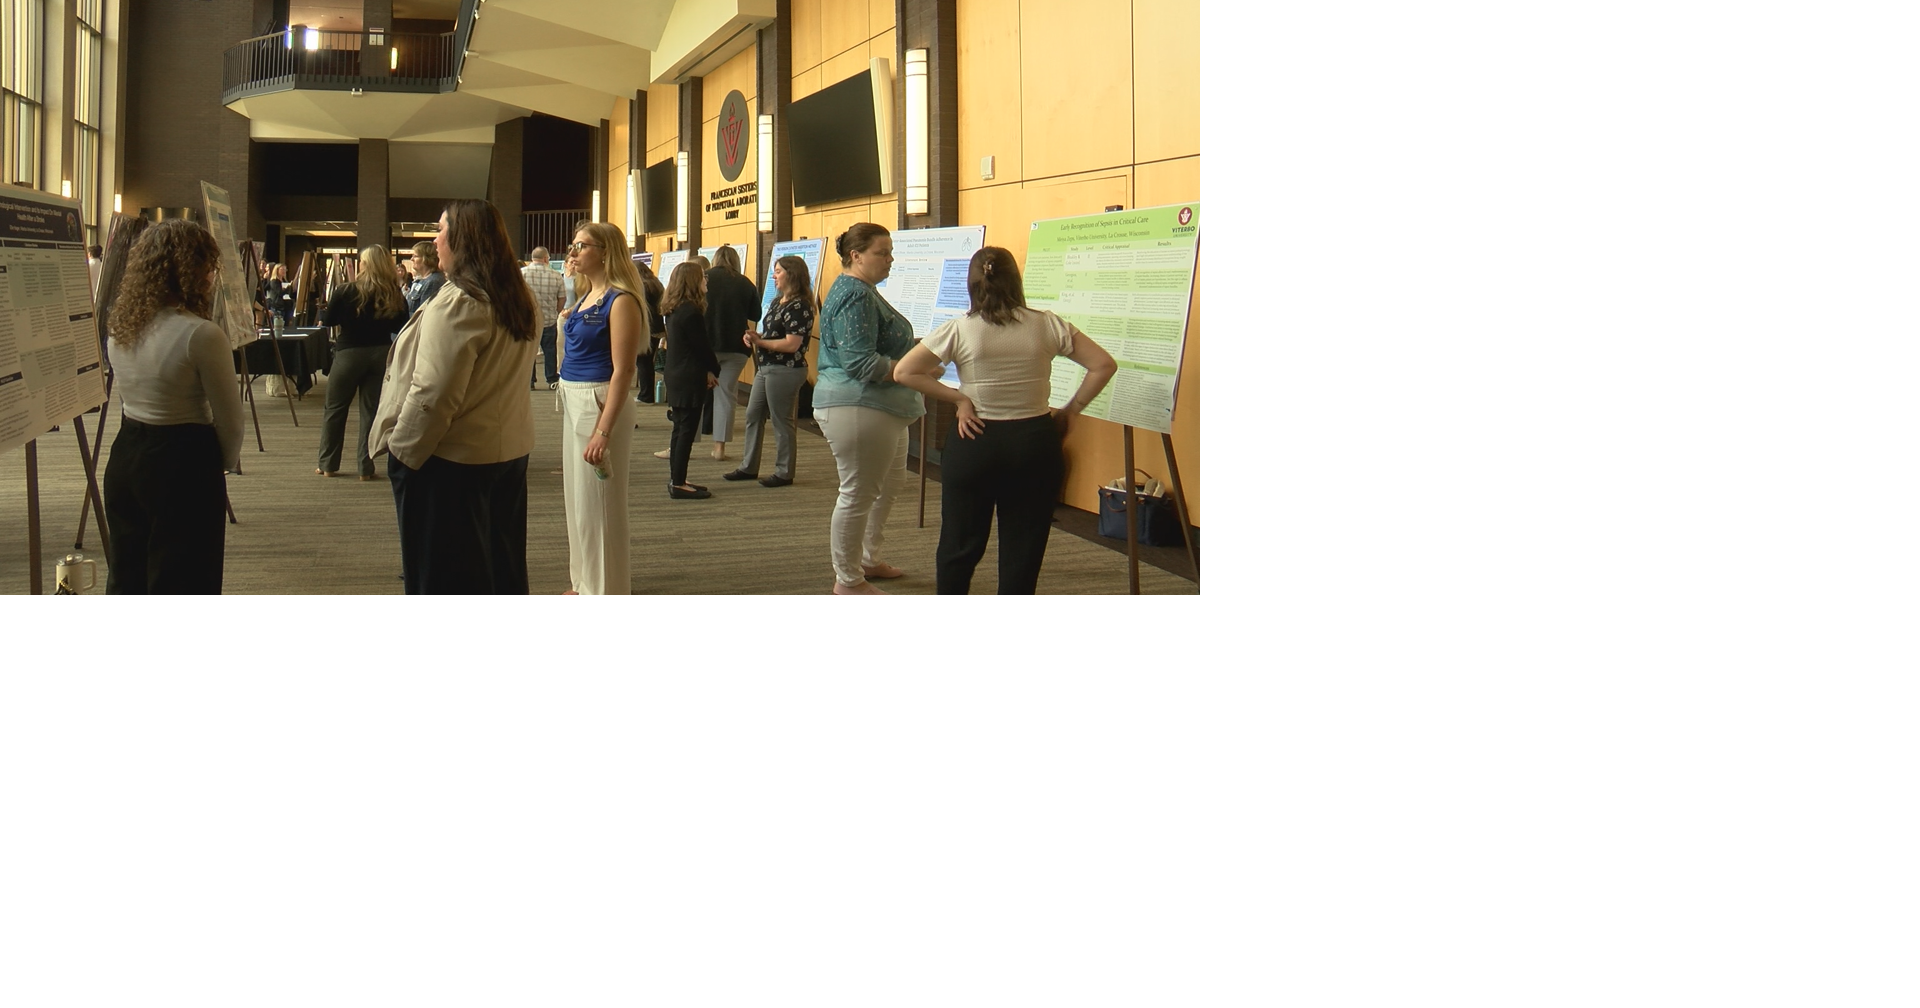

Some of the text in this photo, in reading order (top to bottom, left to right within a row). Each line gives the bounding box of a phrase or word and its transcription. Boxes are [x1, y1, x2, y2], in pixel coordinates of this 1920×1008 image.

[710, 181, 757, 200] FRANCISCAN SISTERS
[706, 194, 757, 212] OF PERPETUAL ADORATI
[726, 210, 740, 220] LOBBY
[1071, 222, 1094, 230] Recognition
[1100, 220, 1112, 228] Sepsis
[1120, 217, 1136, 225] Critical
